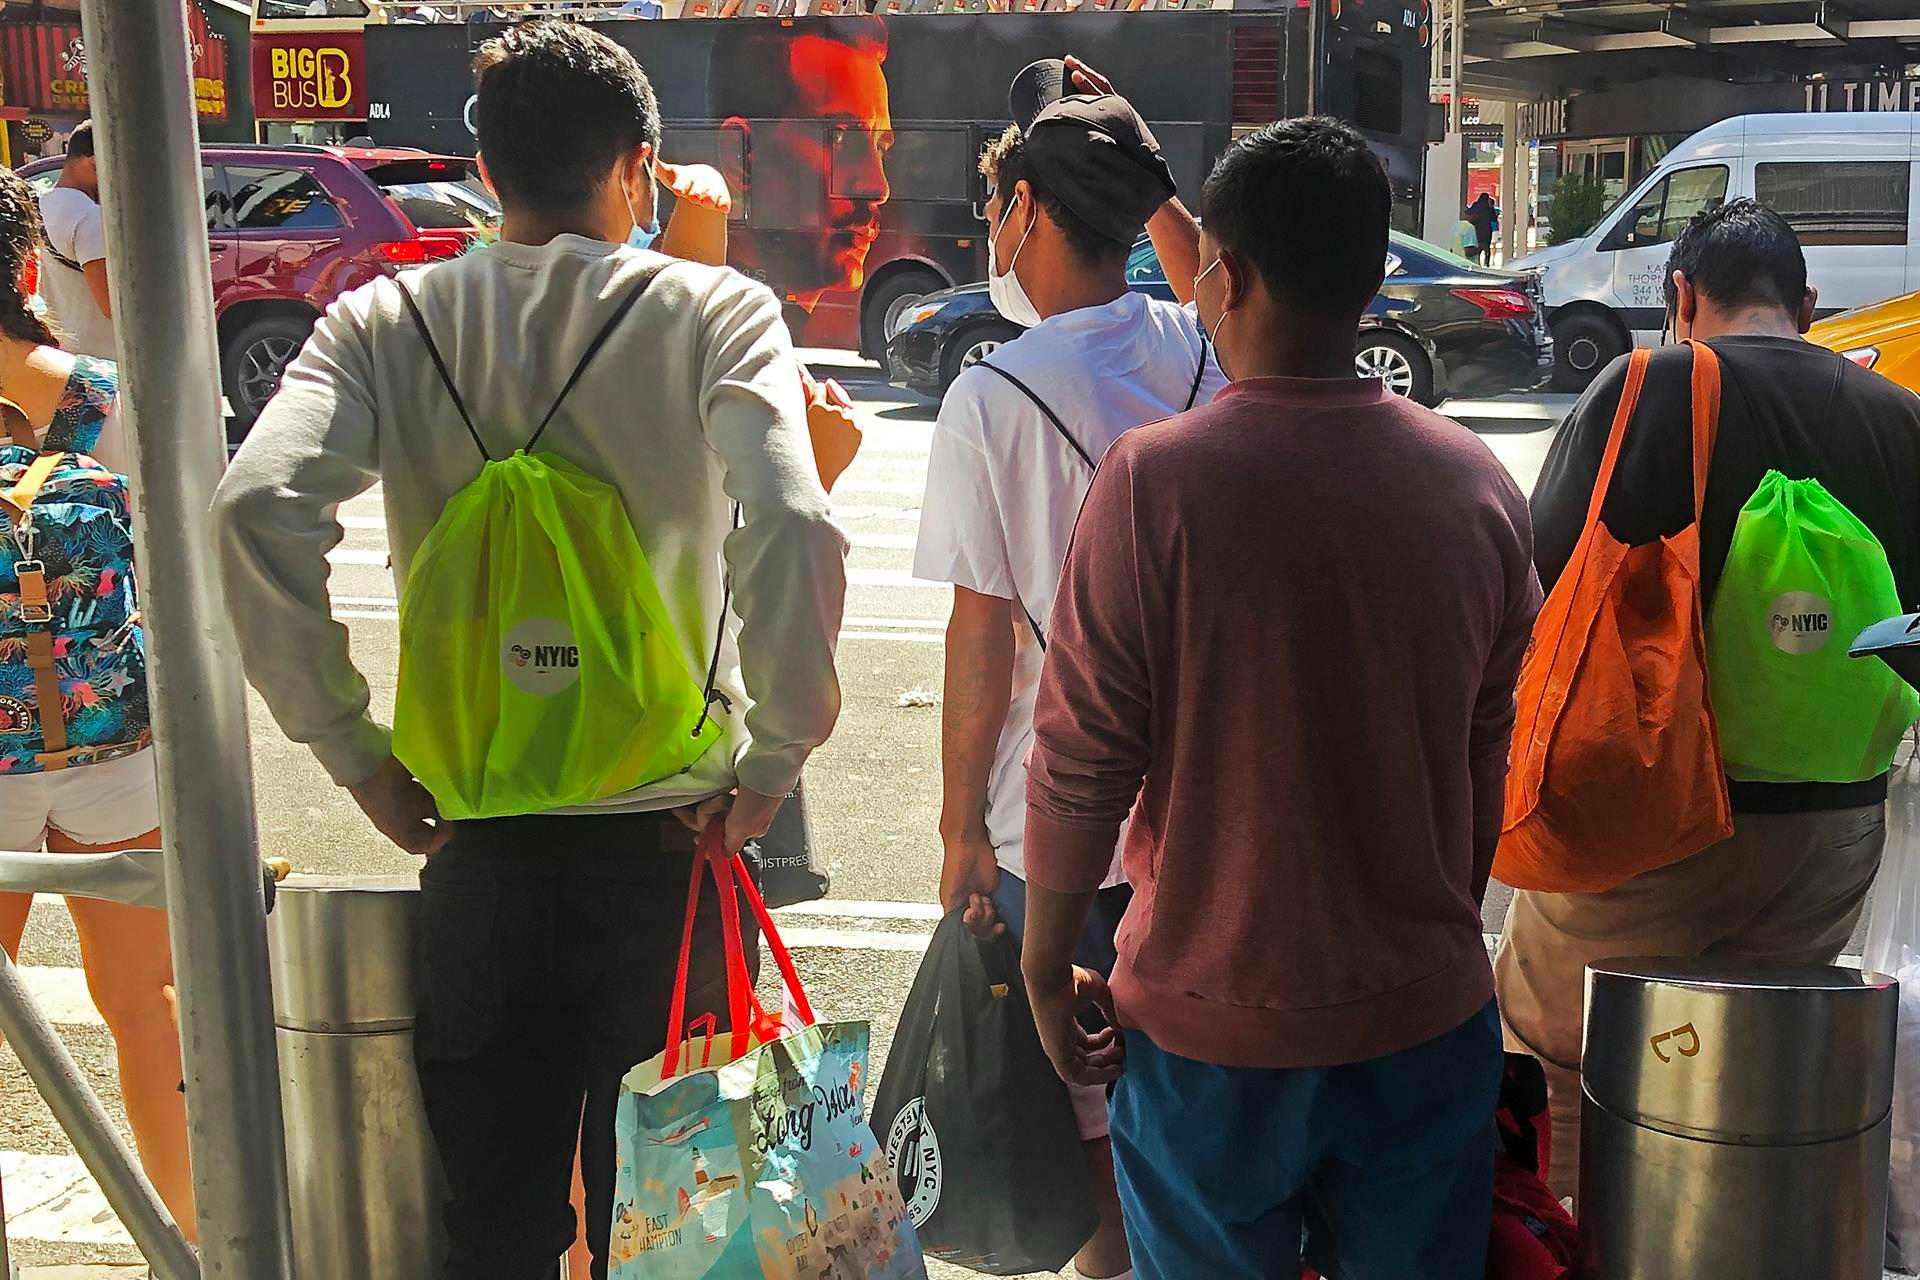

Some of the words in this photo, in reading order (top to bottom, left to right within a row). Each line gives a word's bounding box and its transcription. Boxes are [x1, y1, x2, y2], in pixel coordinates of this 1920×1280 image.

[271, 48, 315, 79] BIG
[273, 80, 317, 108] BUS
[369, 103, 391, 119] ADL4
[1791, 613, 1828, 632] NYIC
[535, 645, 579, 667] NYIC
[755, 1102, 816, 1154] Long
[811, 1077, 856, 1123] Isla
[923, 1147, 938, 1191] NYC
[645, 1213, 669, 1234] EAST
[639, 1228, 682, 1252] HAMPTON
